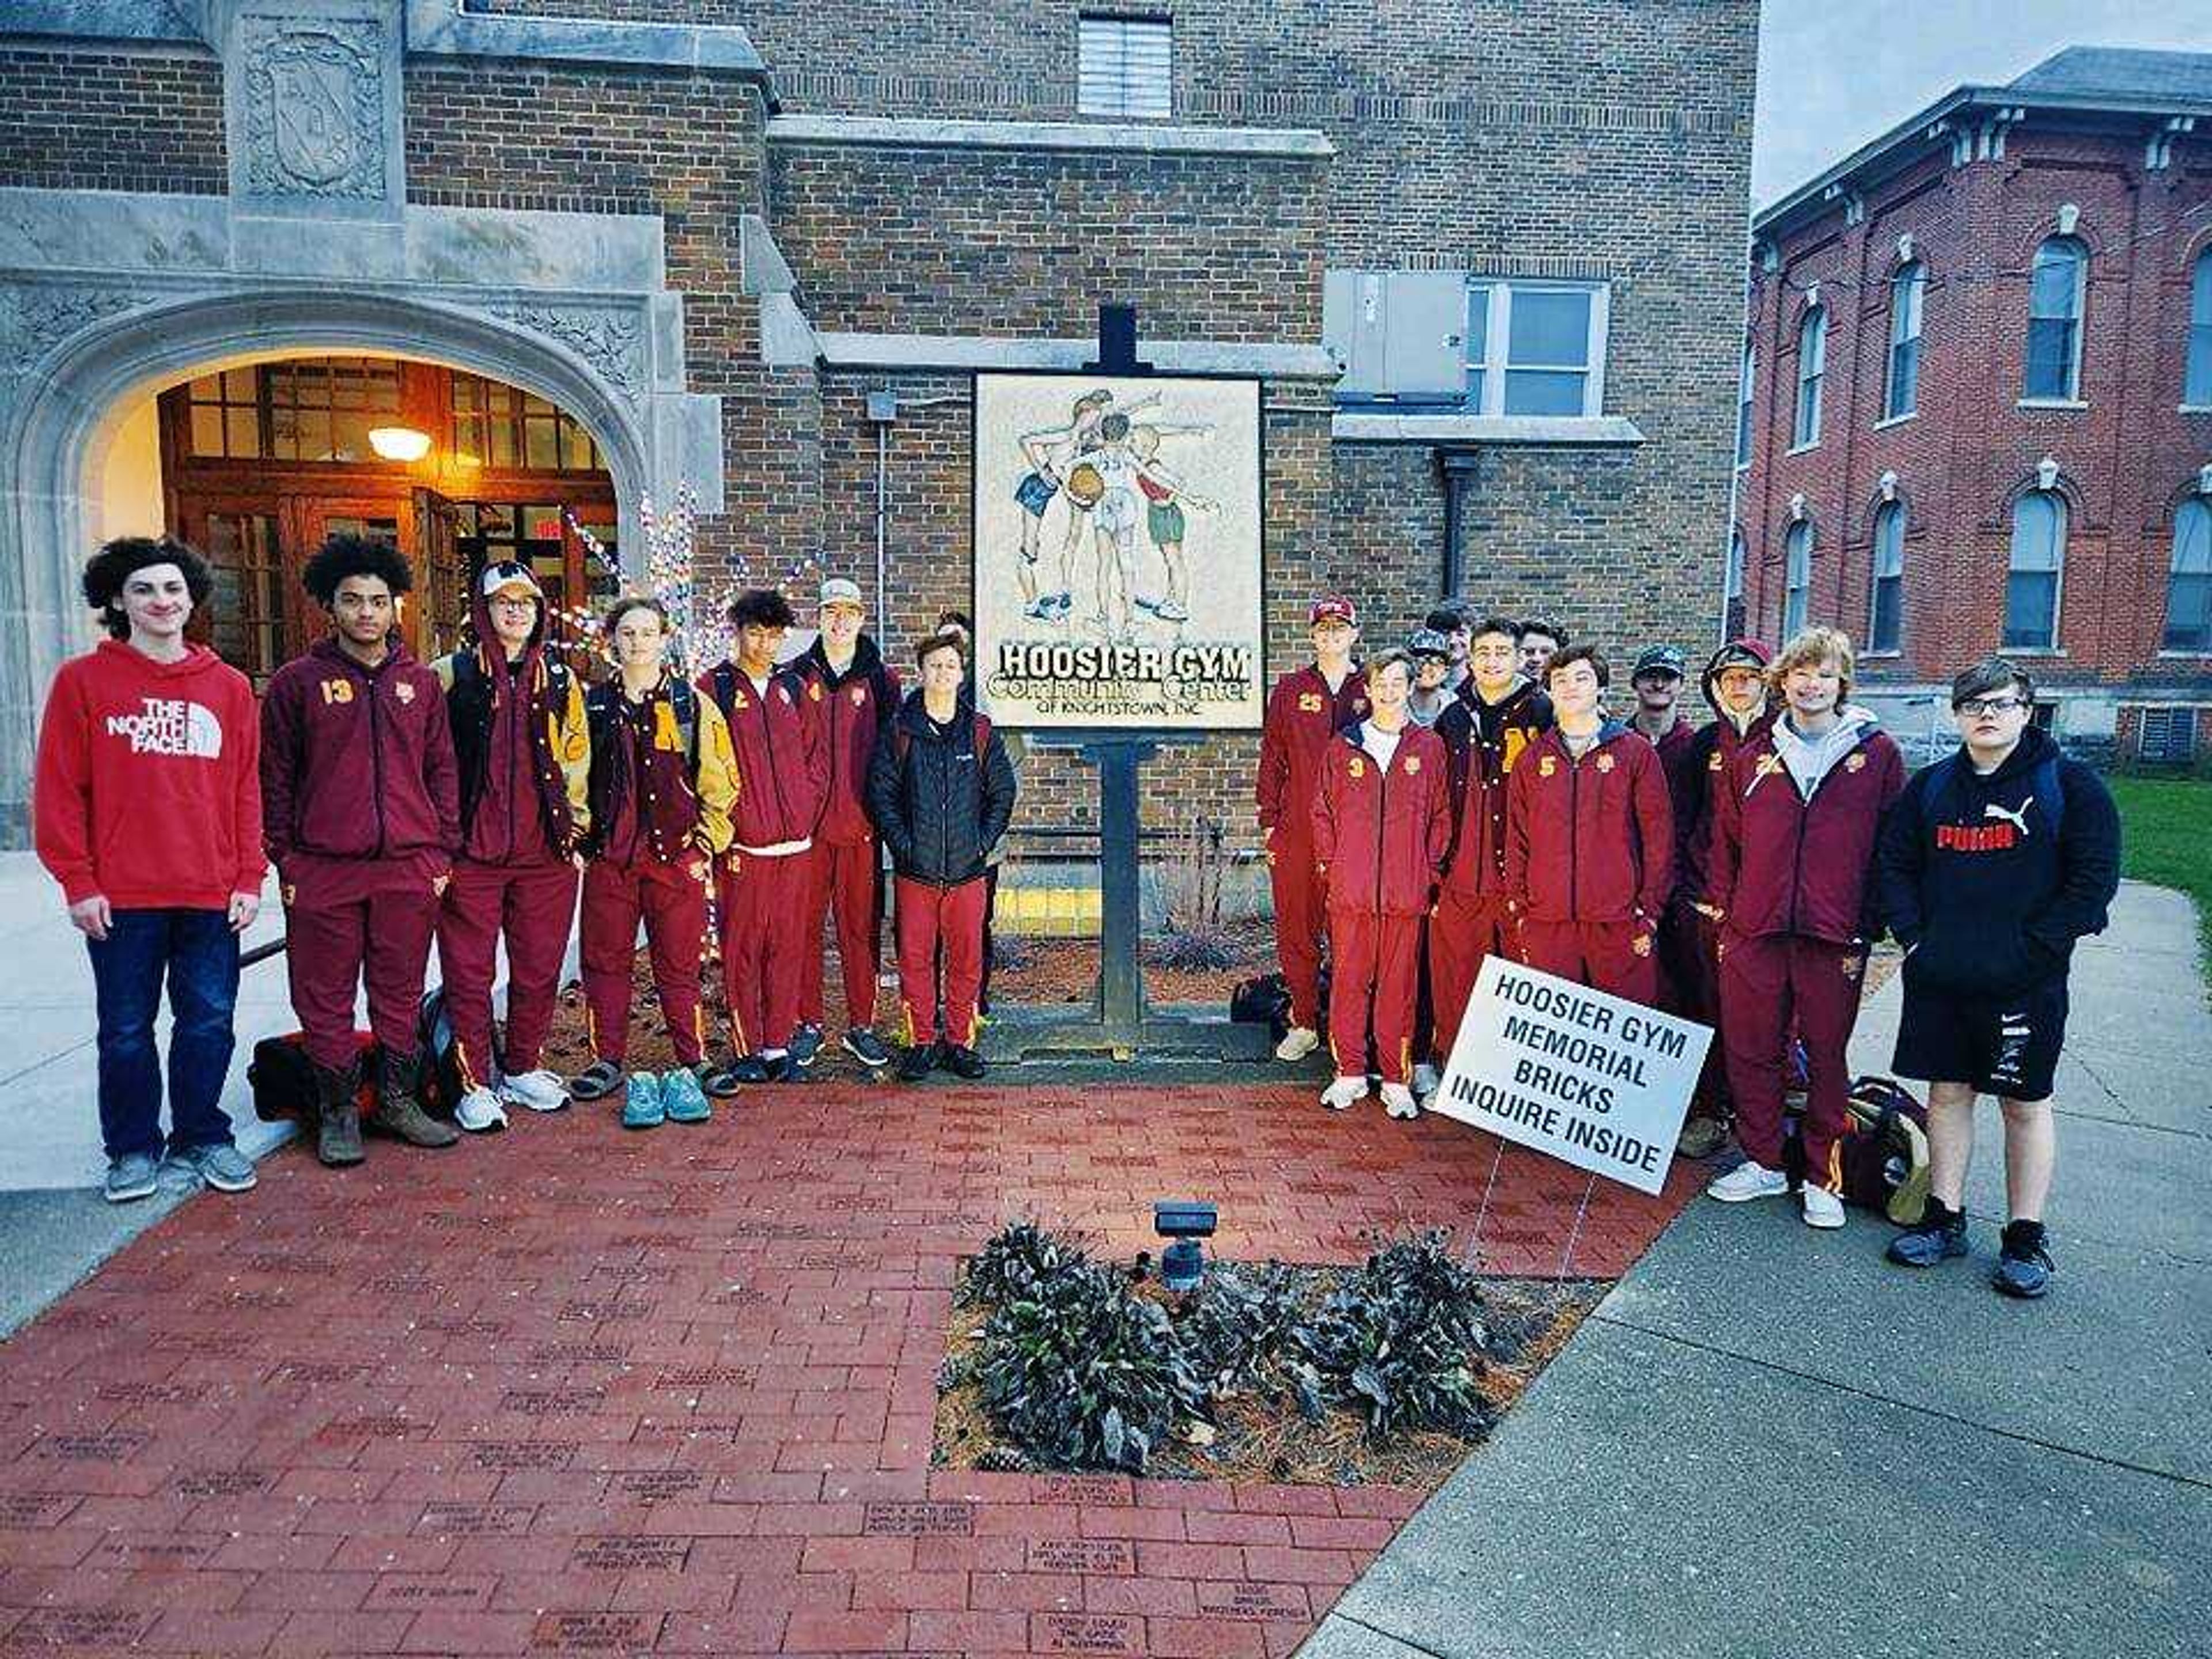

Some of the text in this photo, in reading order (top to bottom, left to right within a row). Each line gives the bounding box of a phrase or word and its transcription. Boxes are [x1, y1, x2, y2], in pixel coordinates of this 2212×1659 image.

[999, 645, 1251, 683] HOOSIER GYM
[320, 679, 354, 704] 13
[1161, 673, 1252, 702] Center
[142, 698, 185, 718] THE
[1036, 700, 1055, 714] OF
[107, 714, 185, 740] NORTH
[131, 734, 188, 756] FACE
[1539, 755, 1556, 778] 5
[1936, 823, 2015, 852] PUMA
[1495, 974, 1688, 1059] HOOSIER GYM
[1503, 1016, 1647, 1088] MEMORIAL
[1513, 1059, 1615, 1114] BRICKS
[1450, 1074, 1661, 1174] INQUIRE INSIDE
